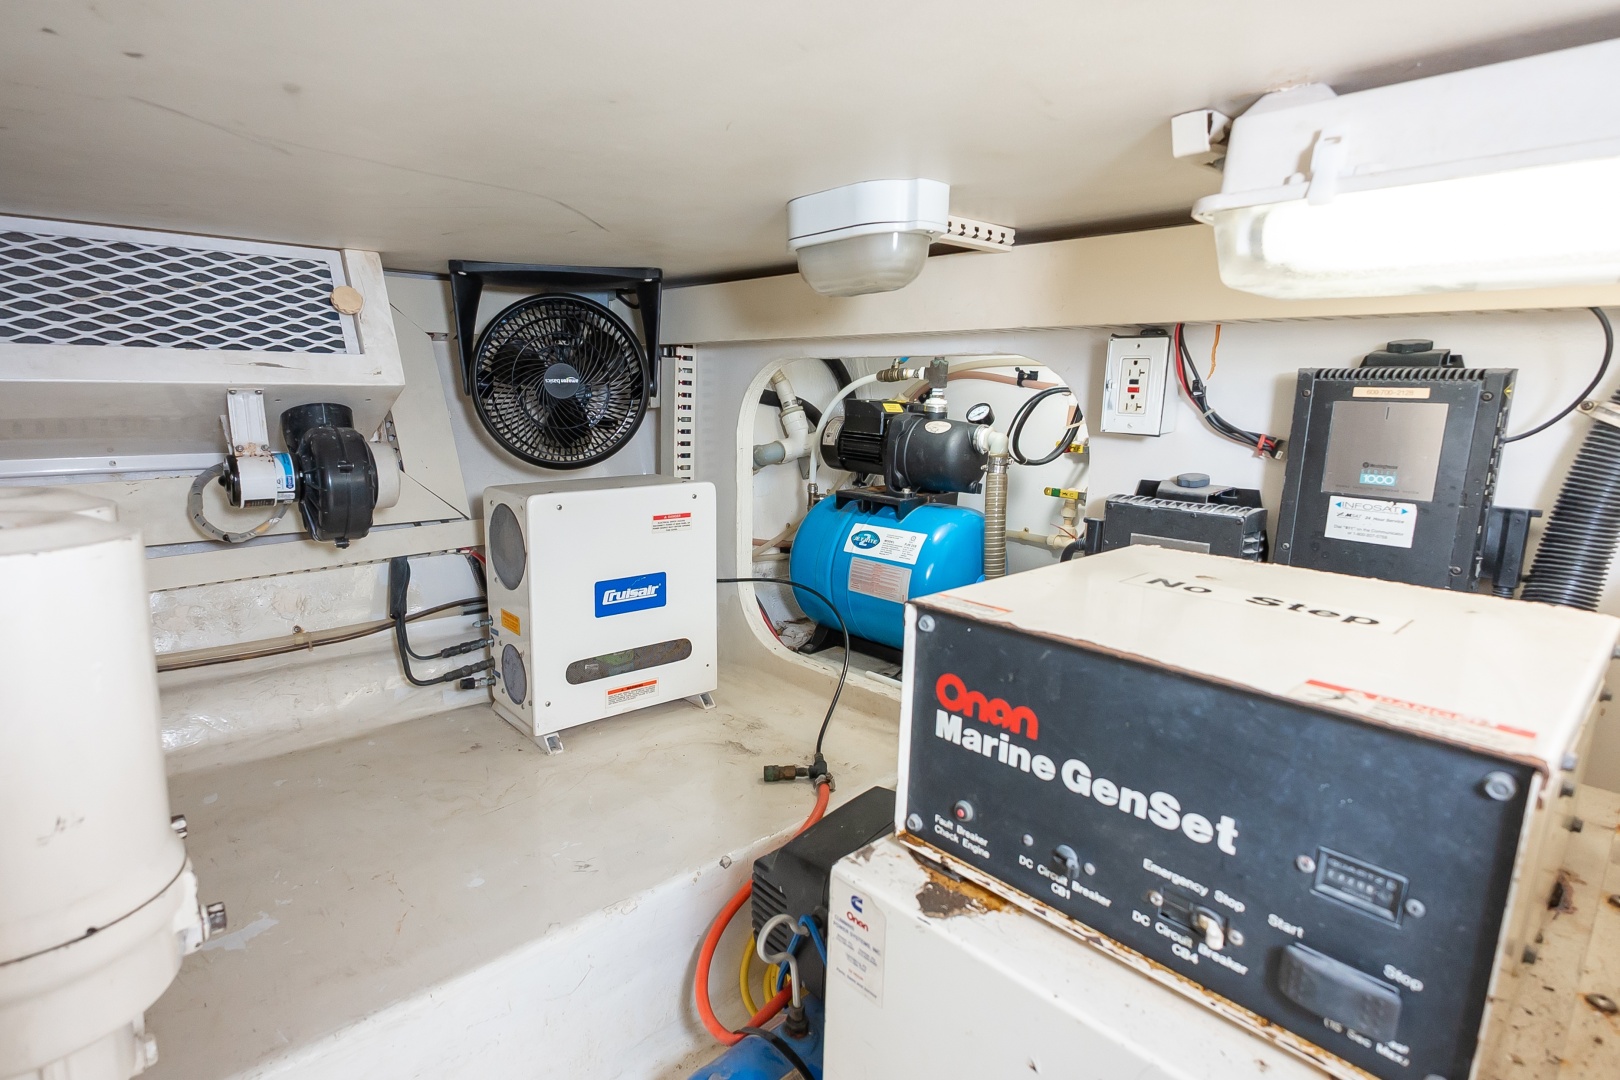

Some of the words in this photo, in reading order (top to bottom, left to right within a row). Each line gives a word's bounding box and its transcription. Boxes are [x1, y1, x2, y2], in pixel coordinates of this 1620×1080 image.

[561, 376, 579, 384] amazon
[1363, 474, 1395, 485] 1000
[1341, 501, 1401, 513] INFOSAT
[602, 583, 661, 606] Cruisair
[1146, 578, 1212, 594] No
[1245, 596, 1380, 625] Step
[935, 673, 1039, 741] Onan
[935, 709, 1056, 781] Marine
[1061, 759, 1239, 856] GenSet
[934, 814, 954, 831] Fault
[956, 825, 989, 847] Breaker
[934, 825, 959, 844] Check
[962, 838, 990, 859] Engine
[1019, 855, 1034, 869] DC
[1037, 864, 1068, 886] Circuit
[1071, 880, 1112, 908] Breaker
[1051, 883, 1071, 900] CB1
[1143, 858, 1209, 897] Emergency
[1214, 889, 1246, 912] Stop
[846, 911, 869, 932] Onan
[1267, 913, 1305, 939] Start
[1132, 909, 1151, 927] DC
[1155, 922, 1193, 949] Circuit
[1198, 942, 1249, 976] Breaker
[1172, 943, 1199, 965] CB4
[1383, 964, 1424, 992] Stop
[1346, 1028, 1373, 1049] Sec
